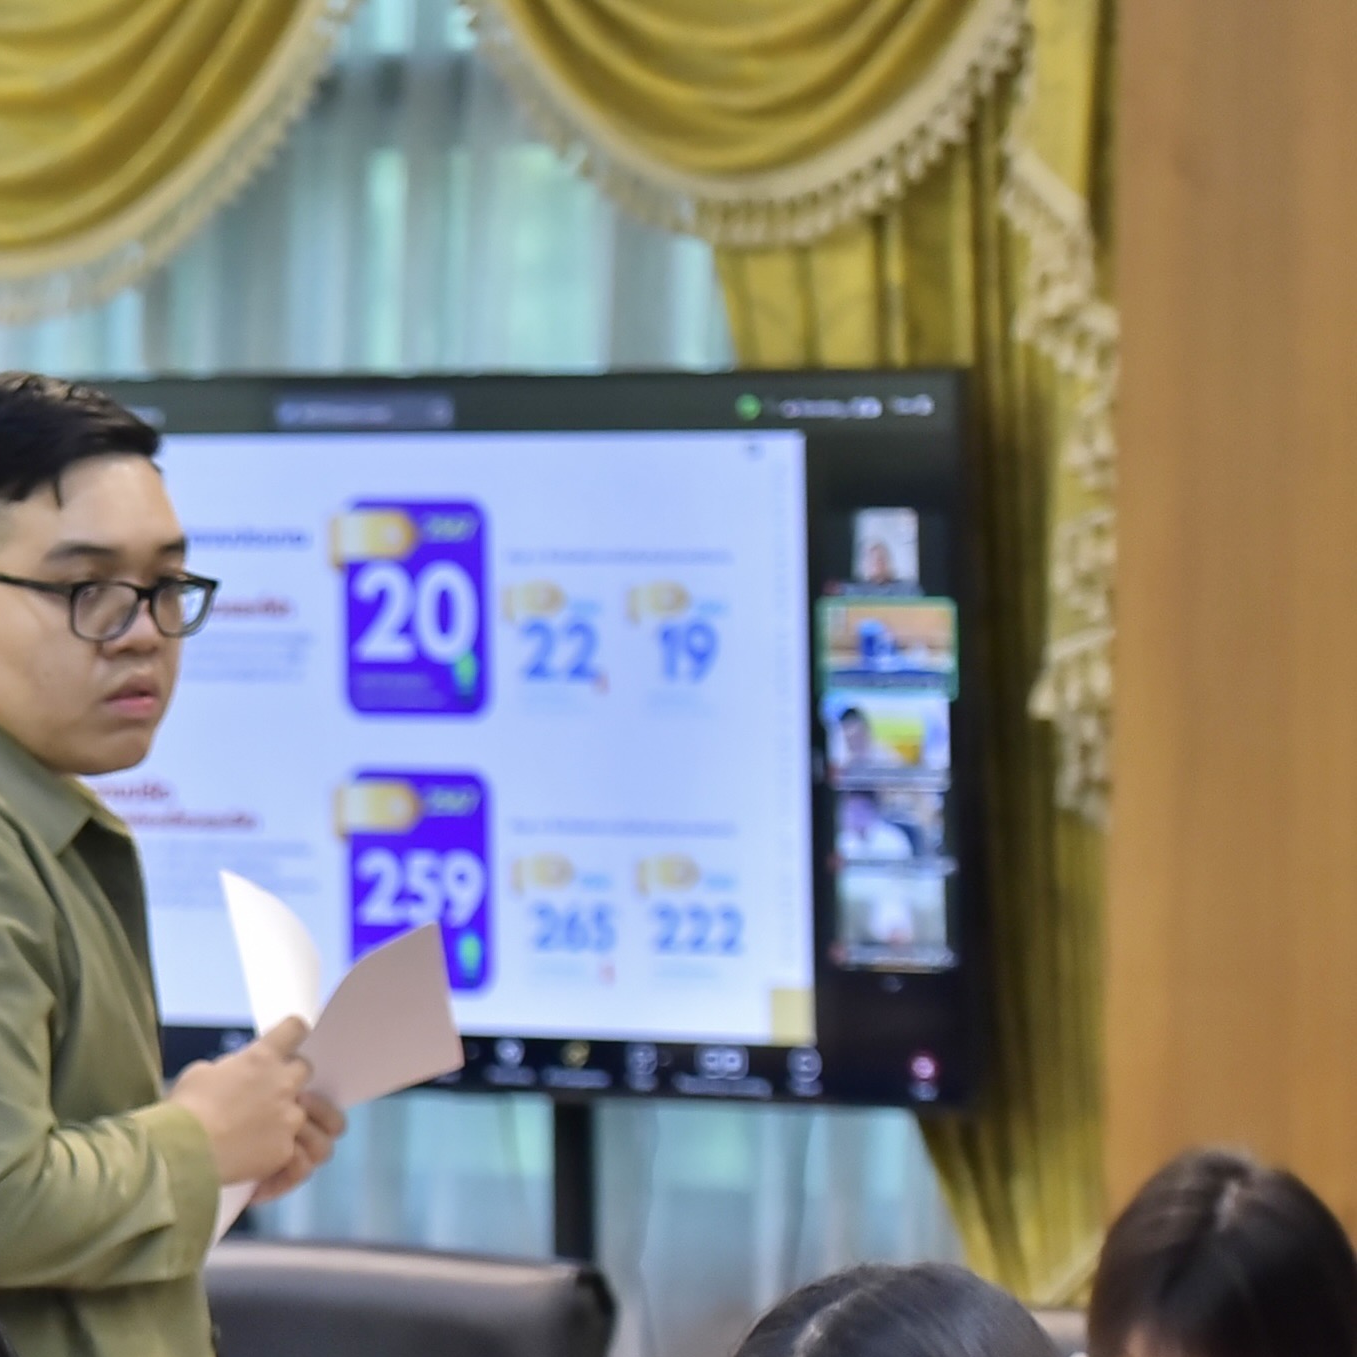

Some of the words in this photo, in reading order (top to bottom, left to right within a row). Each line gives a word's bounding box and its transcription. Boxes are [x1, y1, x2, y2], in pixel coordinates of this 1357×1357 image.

[351, 559, 480, 664] 20
[523, 619, 599, 681] 22
[659, 621, 718, 682] 19
[356, 847, 485, 927] 259
[532, 904, 617, 954] 265
[653, 904, 743, 956] 222
